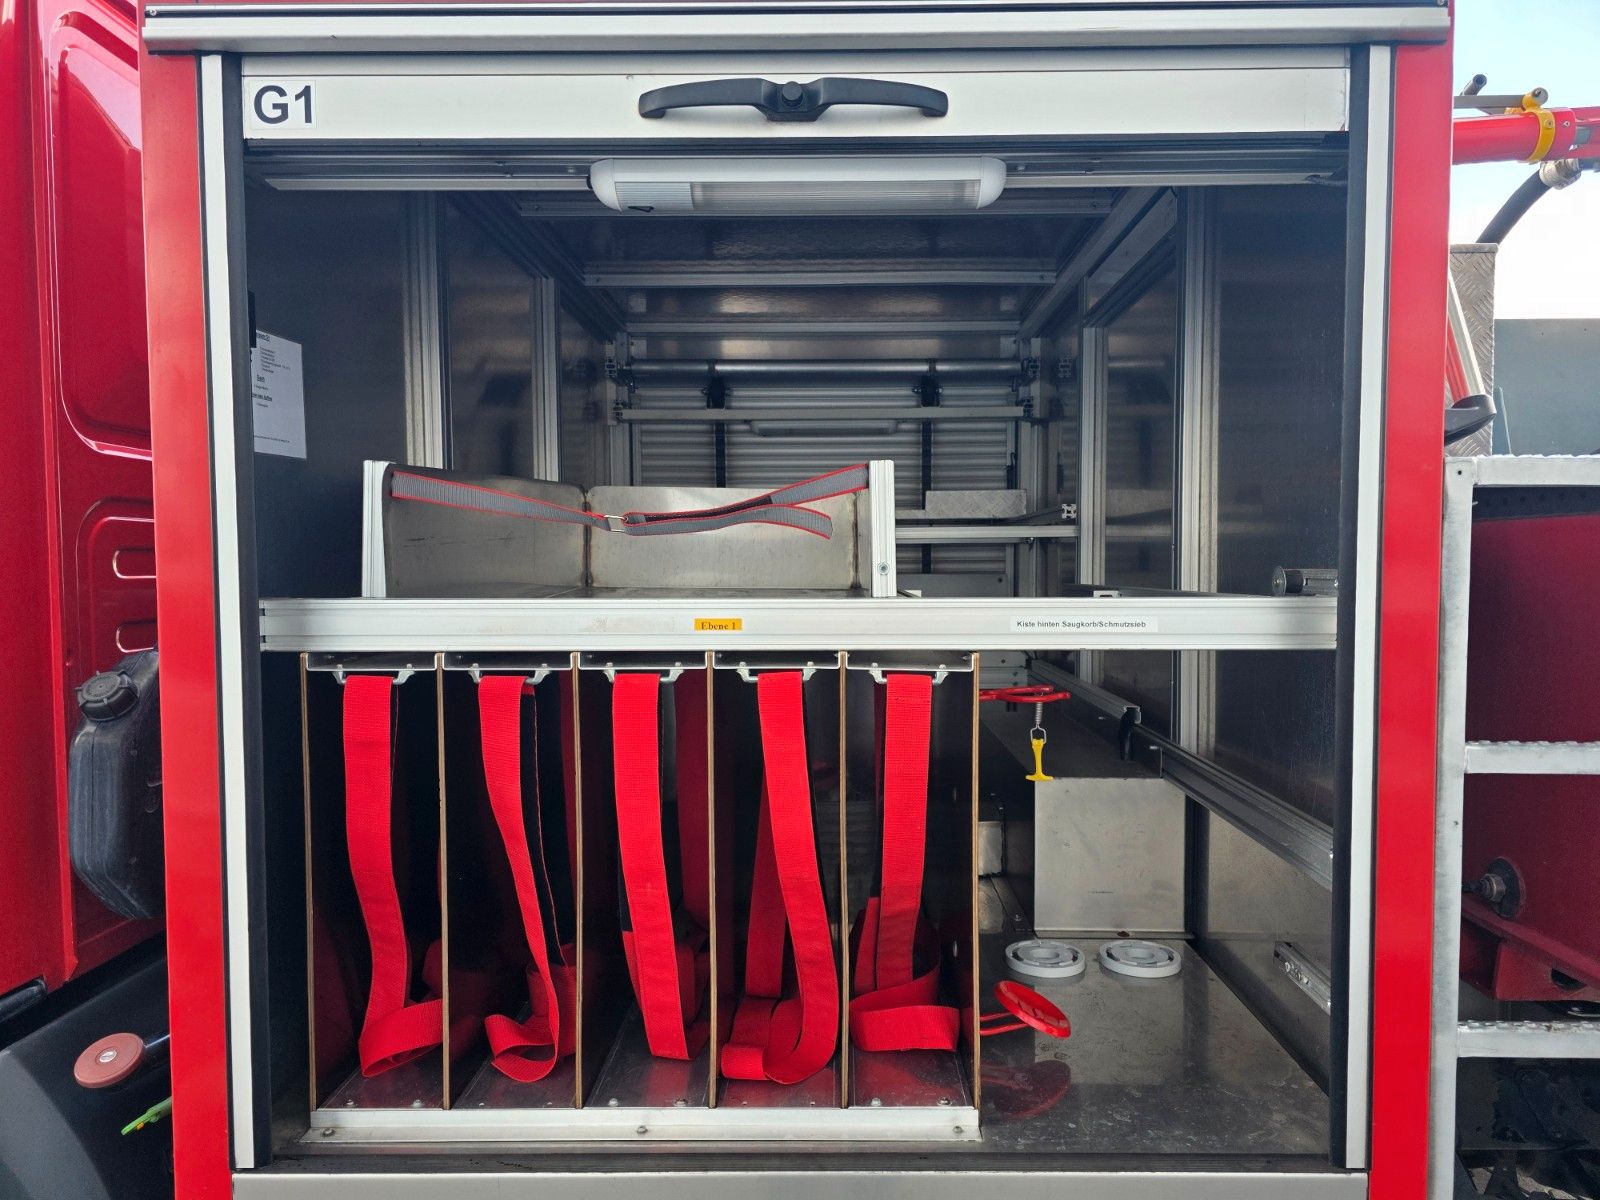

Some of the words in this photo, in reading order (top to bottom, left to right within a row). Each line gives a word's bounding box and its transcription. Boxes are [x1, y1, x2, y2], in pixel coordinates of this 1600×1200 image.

[254, 85, 312, 124] G1
[701, 621, 729, 630] Ebene
[1062, 621, 1147, 629] Saugkorb/Schmutzsieb
